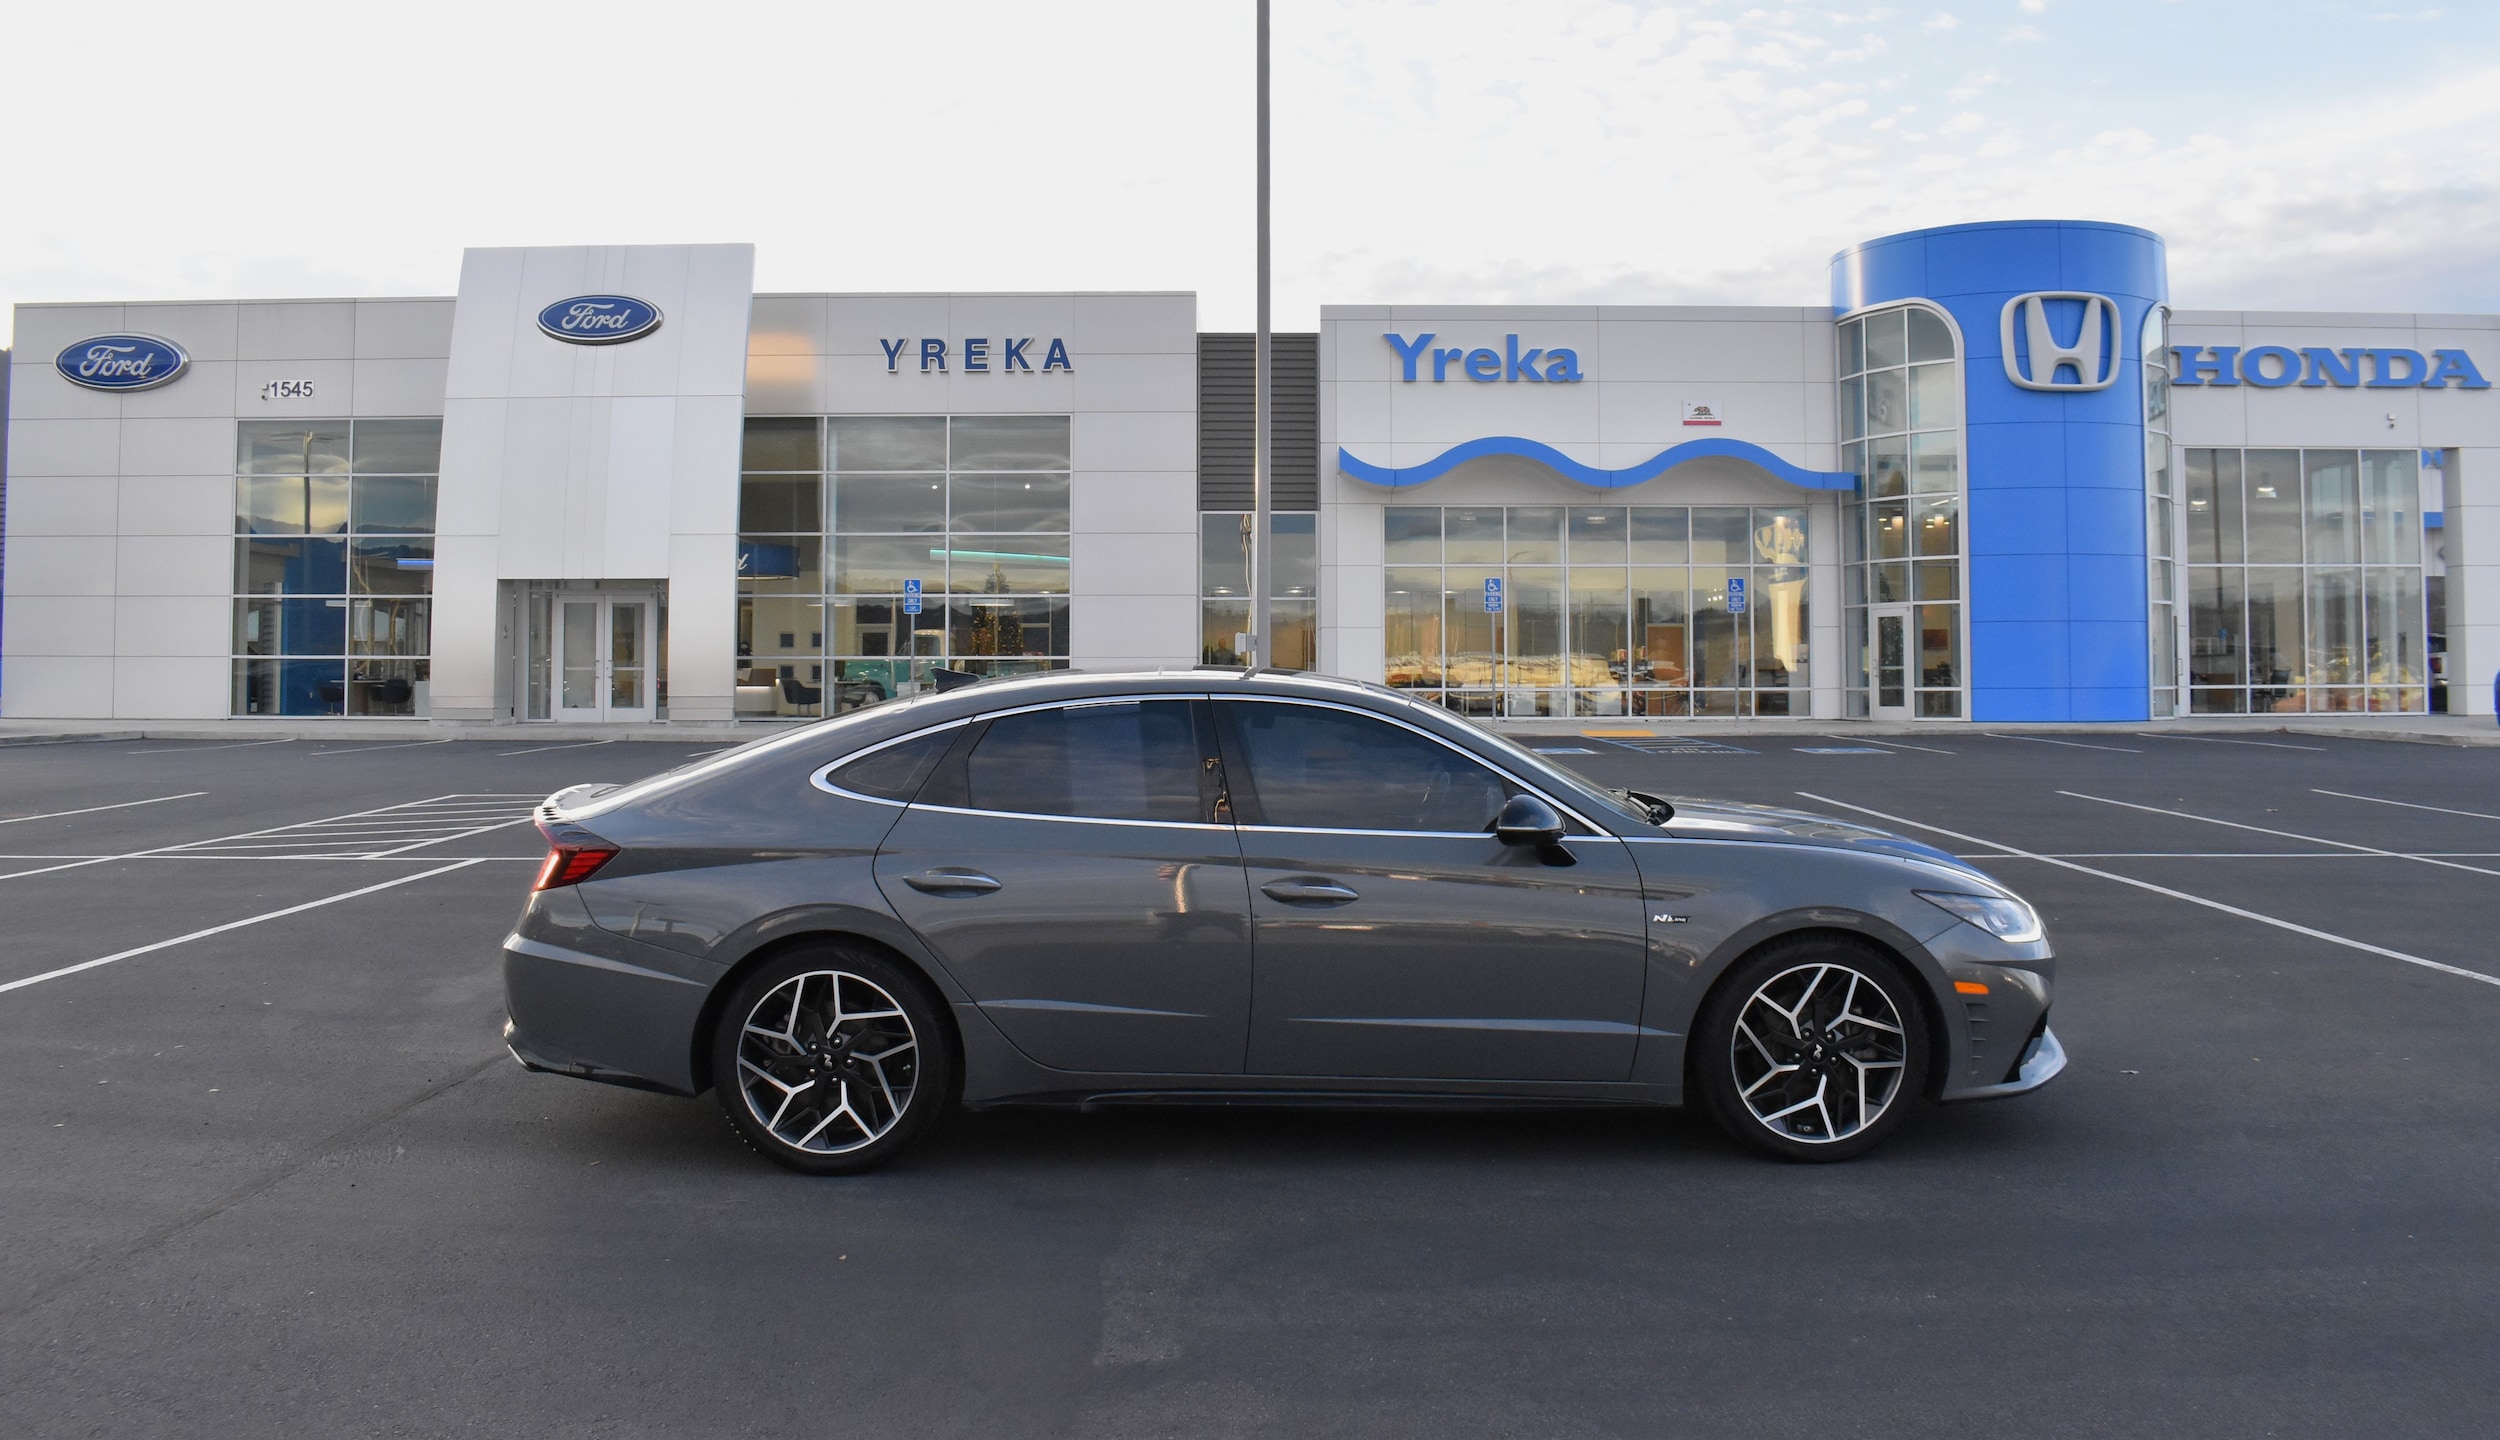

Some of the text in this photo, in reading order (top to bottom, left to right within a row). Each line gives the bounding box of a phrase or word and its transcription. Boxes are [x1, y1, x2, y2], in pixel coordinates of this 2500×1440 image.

[561, 302, 632, 330] Ford
[79, 344, 155, 377] Ford
[879, 338, 1074, 372] YREKA
[1382, 333, 1584, 383] Yreka
[2170, 345, 2492, 388] HONDA
[270, 381, 313, 397] 1545
